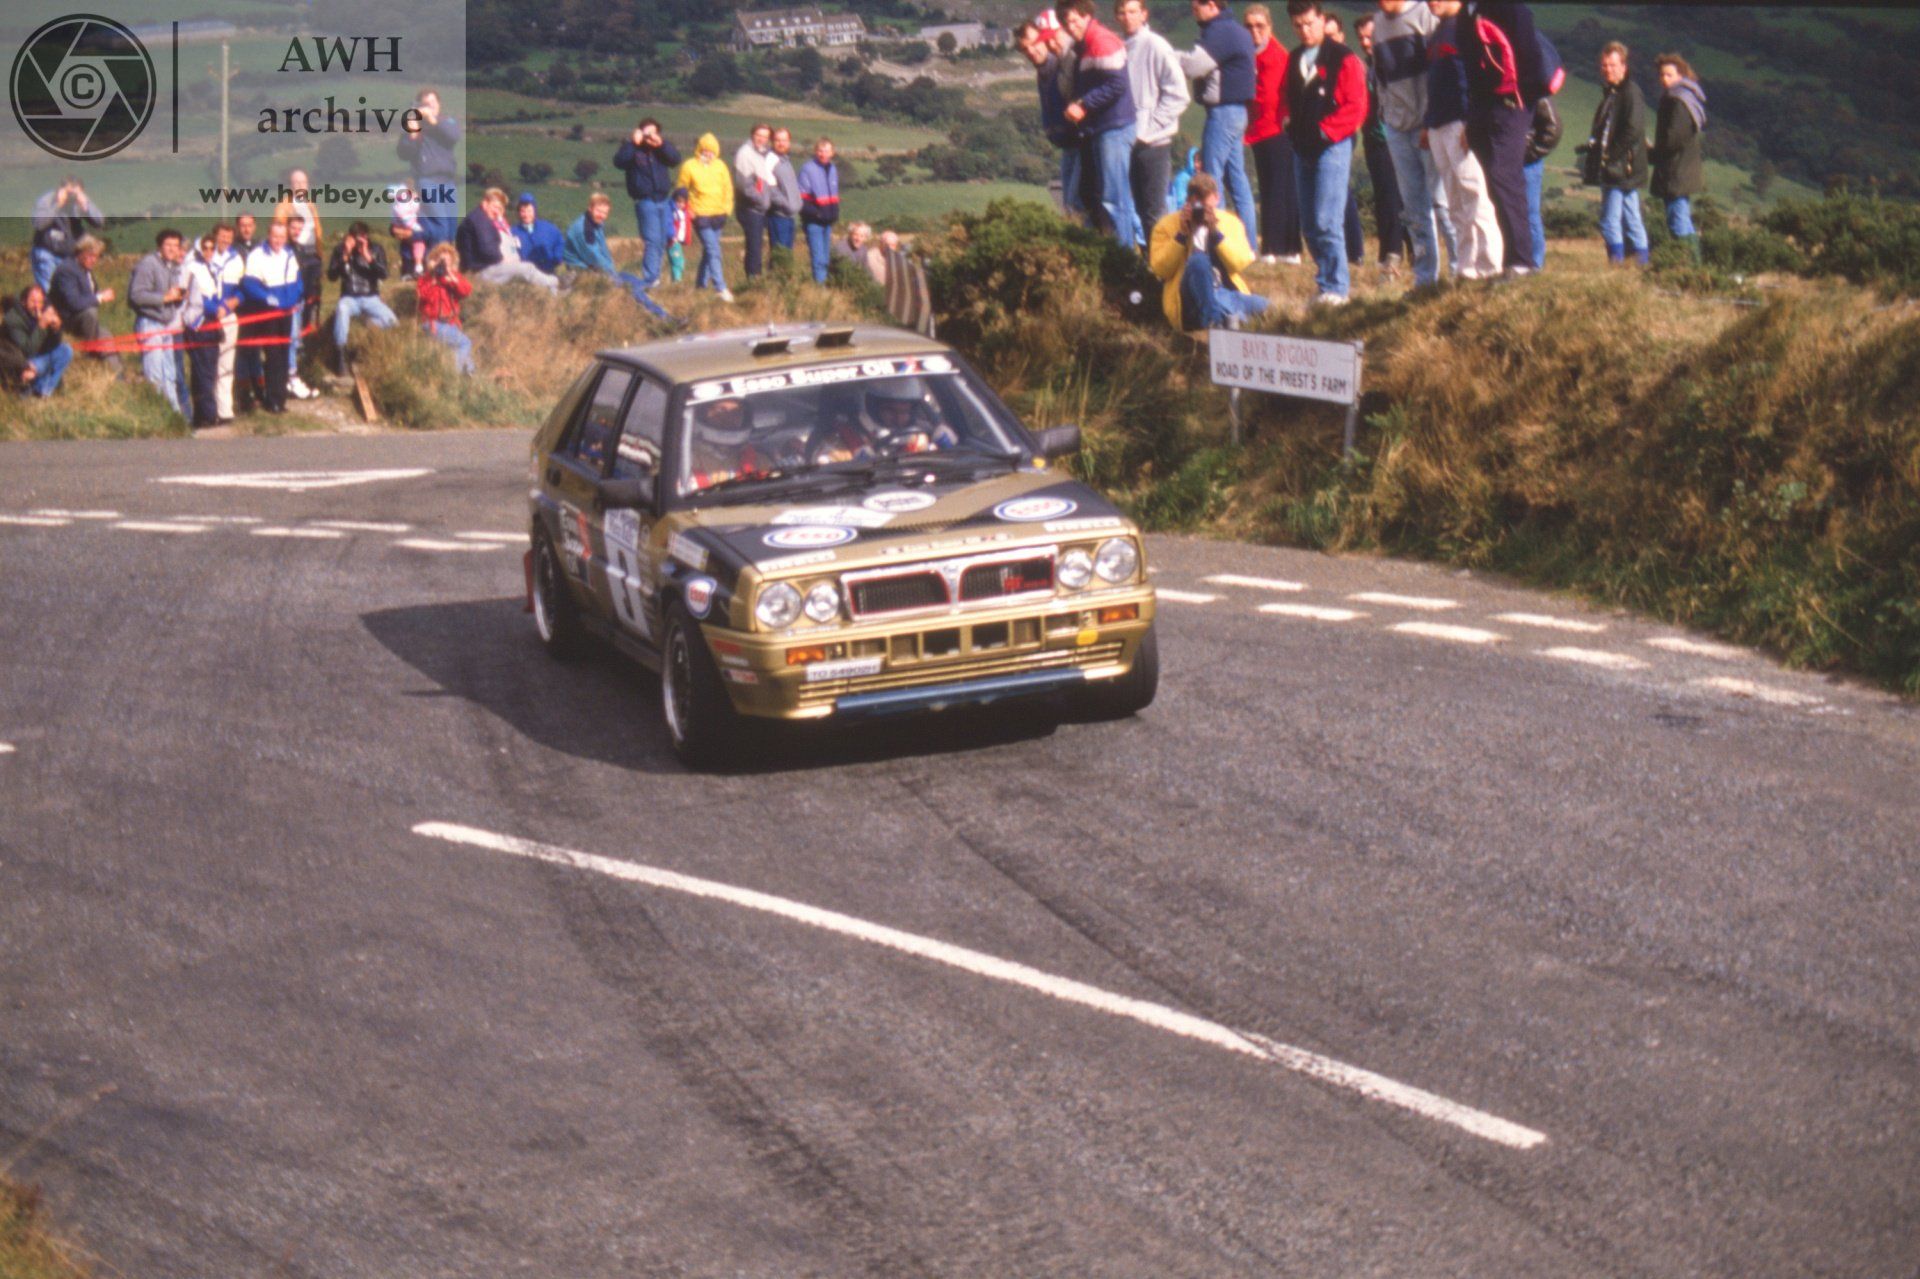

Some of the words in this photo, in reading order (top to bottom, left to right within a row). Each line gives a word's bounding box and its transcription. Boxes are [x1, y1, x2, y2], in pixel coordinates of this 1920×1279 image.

[1215, 362, 1240, 379] ROAD
[1243, 364, 1254, 381] OF
[1258, 367, 1275, 385] THE
[1321, 376, 1348, 395] FARM
